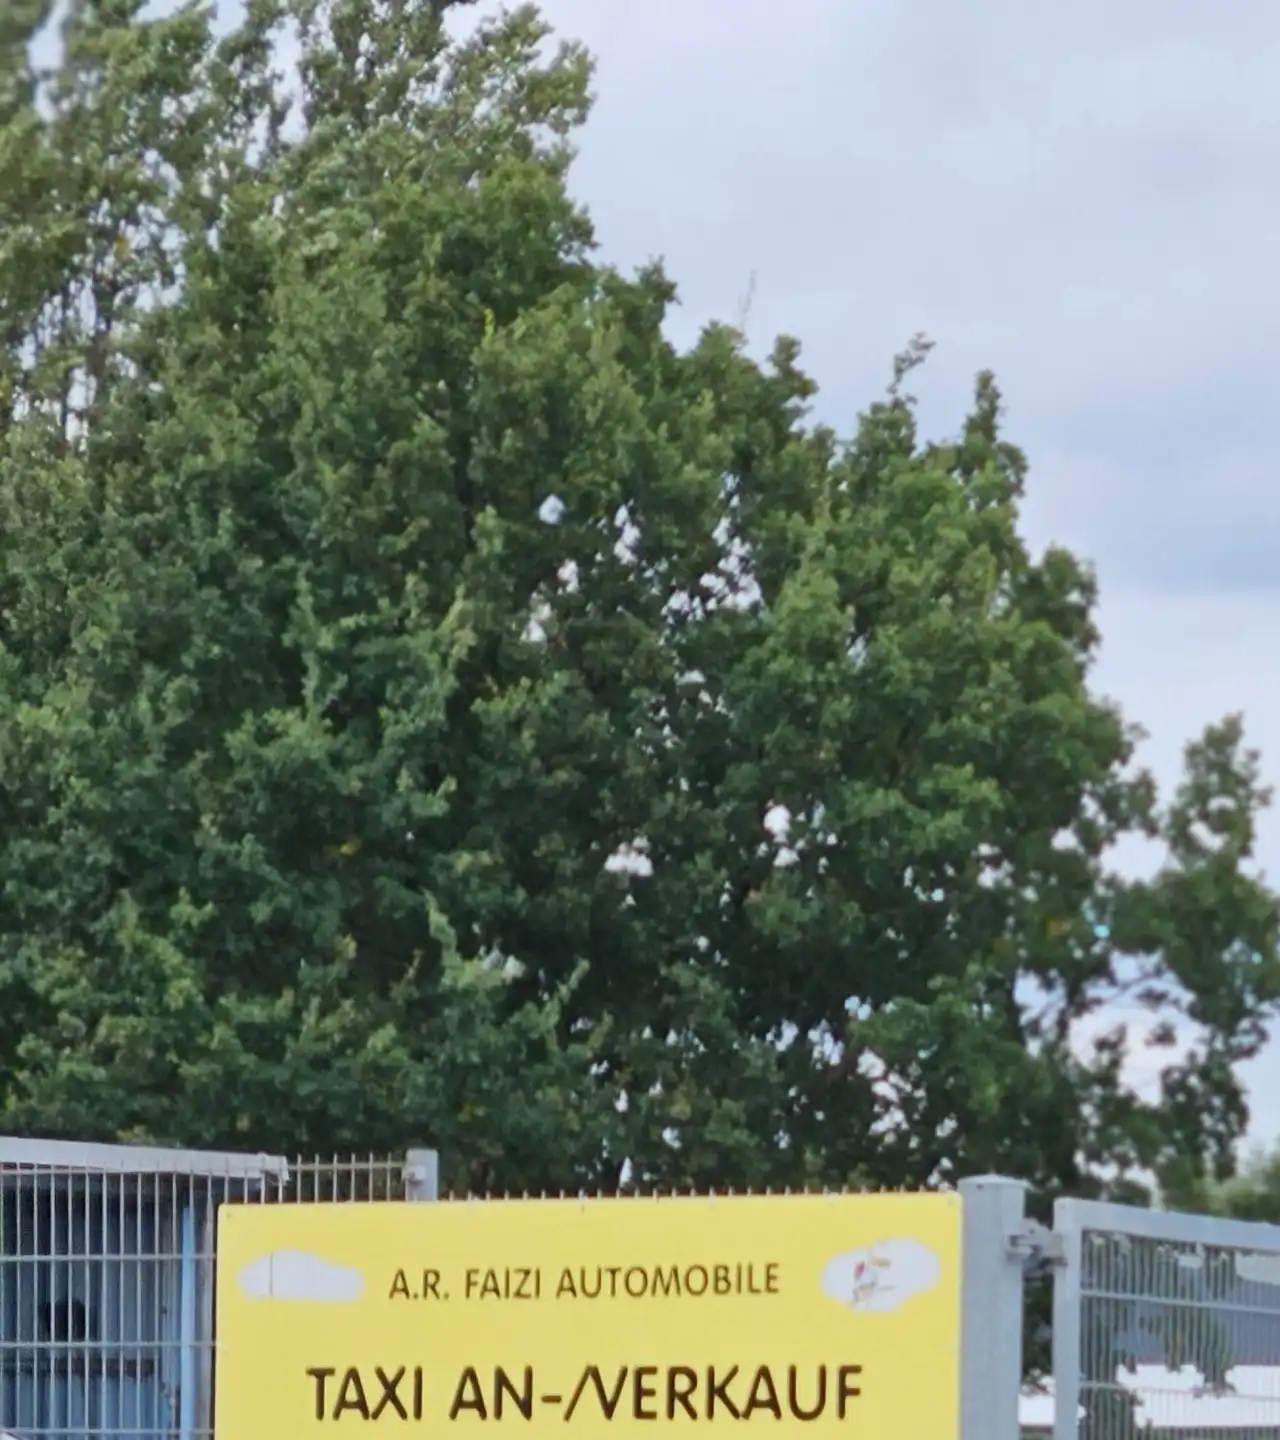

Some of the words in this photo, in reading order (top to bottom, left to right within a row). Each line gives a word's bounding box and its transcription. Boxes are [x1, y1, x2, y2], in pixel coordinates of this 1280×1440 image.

[388, 1268, 449, 1301] A.R.
[465, 1266, 542, 1300] FAIZI
[555, 1262, 781, 1299] AUTOMOBILE
[305, 1364, 424, 1422] TAXI
[447, 1363, 864, 1422] AN-/VERKAUF
